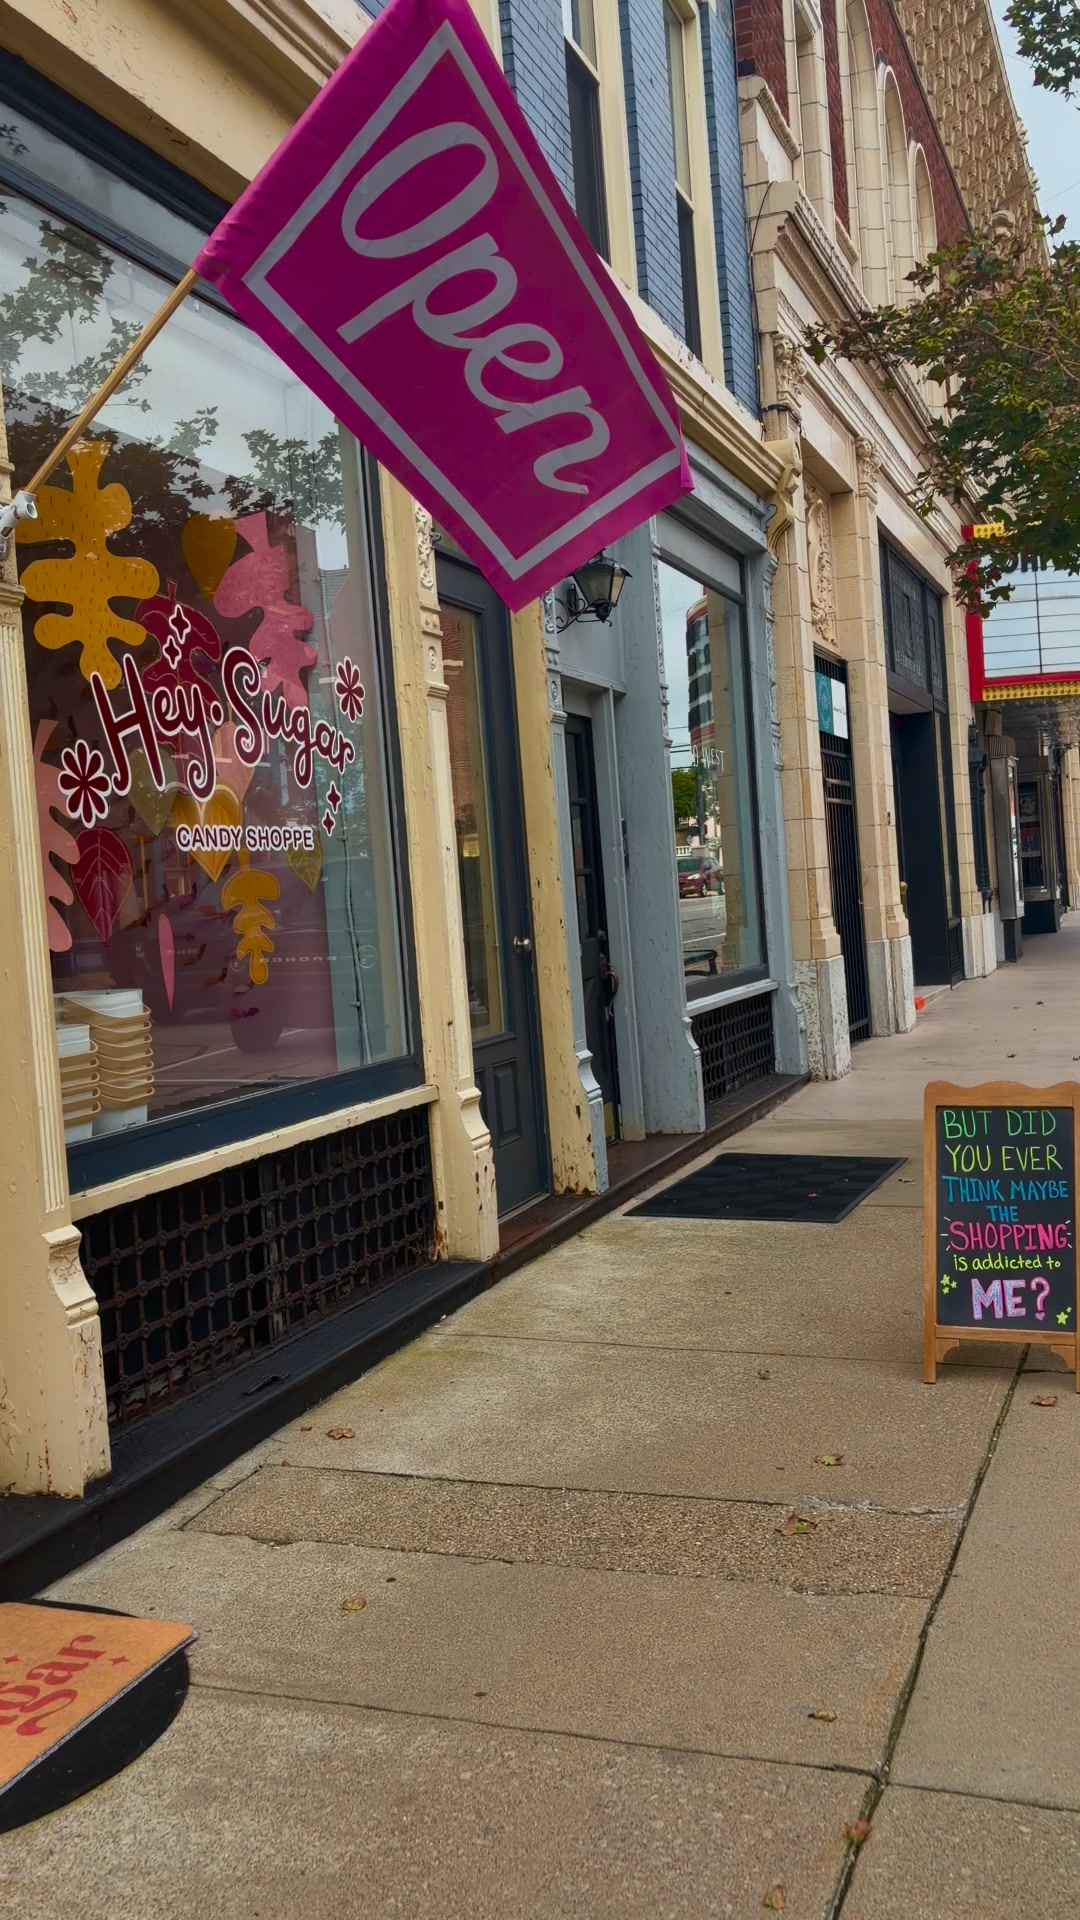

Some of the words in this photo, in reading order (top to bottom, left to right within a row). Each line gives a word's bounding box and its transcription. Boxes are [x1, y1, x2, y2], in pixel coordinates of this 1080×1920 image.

[336, 122, 610, 494] Open
[222, 646, 355, 789] Sugar
[176, 824, 243, 852] CANDY
[246, 826, 314, 851] SHOPPE
[943, 1110, 993, 1139] BUT
[1006, 1110, 1056, 1137] DID
[945, 1144, 992, 1172] YOU
[1002, 1144, 1063, 1171] EVER
[942, 1175, 1004, 1202] THINK
[1010, 1179, 1069, 1200] MAYBE
[986, 1205, 1019, 1222] THE
[949, 1220, 1069, 1251] SHOPPING
[953, 1254, 969, 1271] is
[972, 1253, 1043, 1270] addicted
[1046, 1255, 1061, 1269] to
[970, 1276, 1051, 1321] ME?
